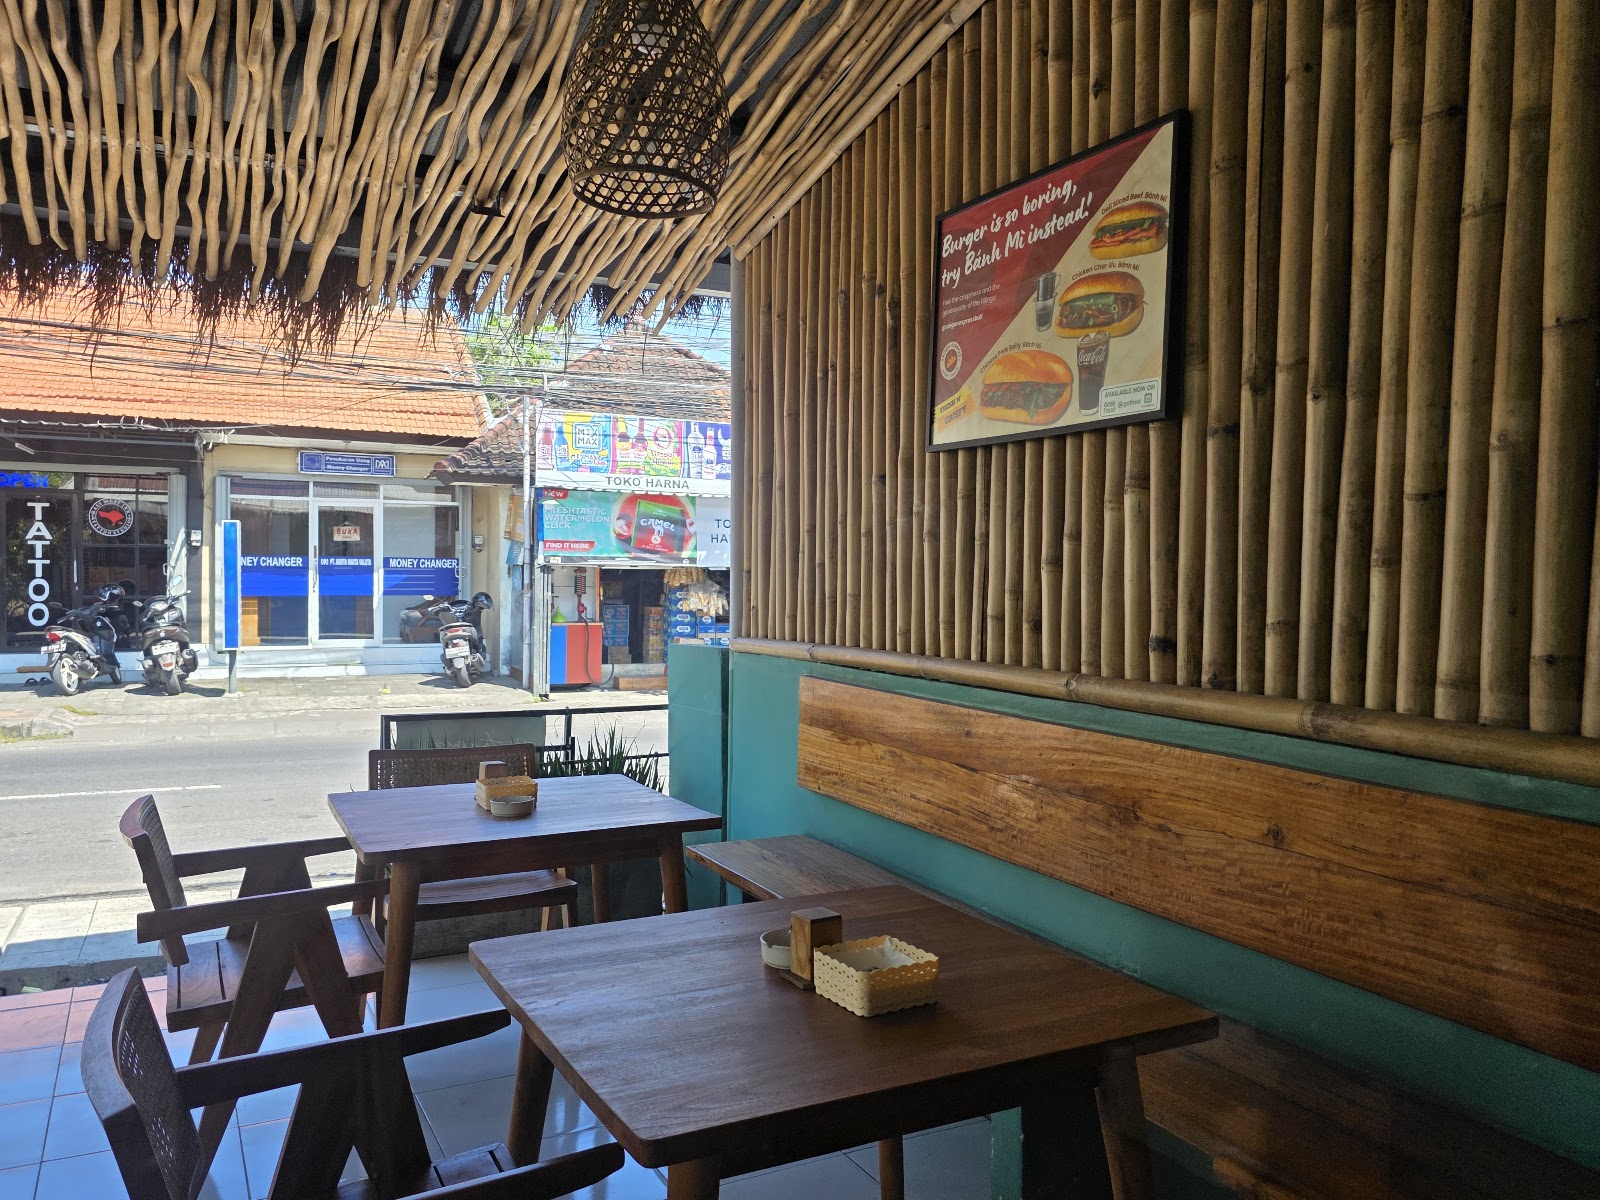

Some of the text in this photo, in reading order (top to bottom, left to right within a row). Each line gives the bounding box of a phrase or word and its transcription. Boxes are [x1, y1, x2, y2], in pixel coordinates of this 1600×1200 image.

[1101, 203, 1112, 215] Deli
[1112, 194, 1130, 207] Sliced
[1130, 191, 1144, 200] Beef
[942, 179, 1077, 258] Burger is so boring,
[941, 191, 1093, 289] try Bánh Mì instead!
[1071, 266, 1094, 281] Chicken
[1093, 263, 1107, 271] Char
[981, 285, 992, 294] and
[1104, 387, 1133, 398] AVAILABLE
[1132, 385, 1147, 394] NOW
[944, 404, 967, 425] CRISPY
[577, 427, 598, 438] MIX
[577, 437, 598, 446] MAX
[0, 472, 49, 488] OPEN
[605, 476, 690, 490] TOKO HARNA
[544, 506, 608, 515] FRESHTASTIC
[544, 514, 610, 523] WATERMELON
[640, 519, 676, 532] CAMEL
[711, 534, 729, 543] HA
[25, 502, 53, 627] TATTOO
[260, 556, 303, 567] CHANGER
[389, 558, 458, 569] MONEY CHANGER
